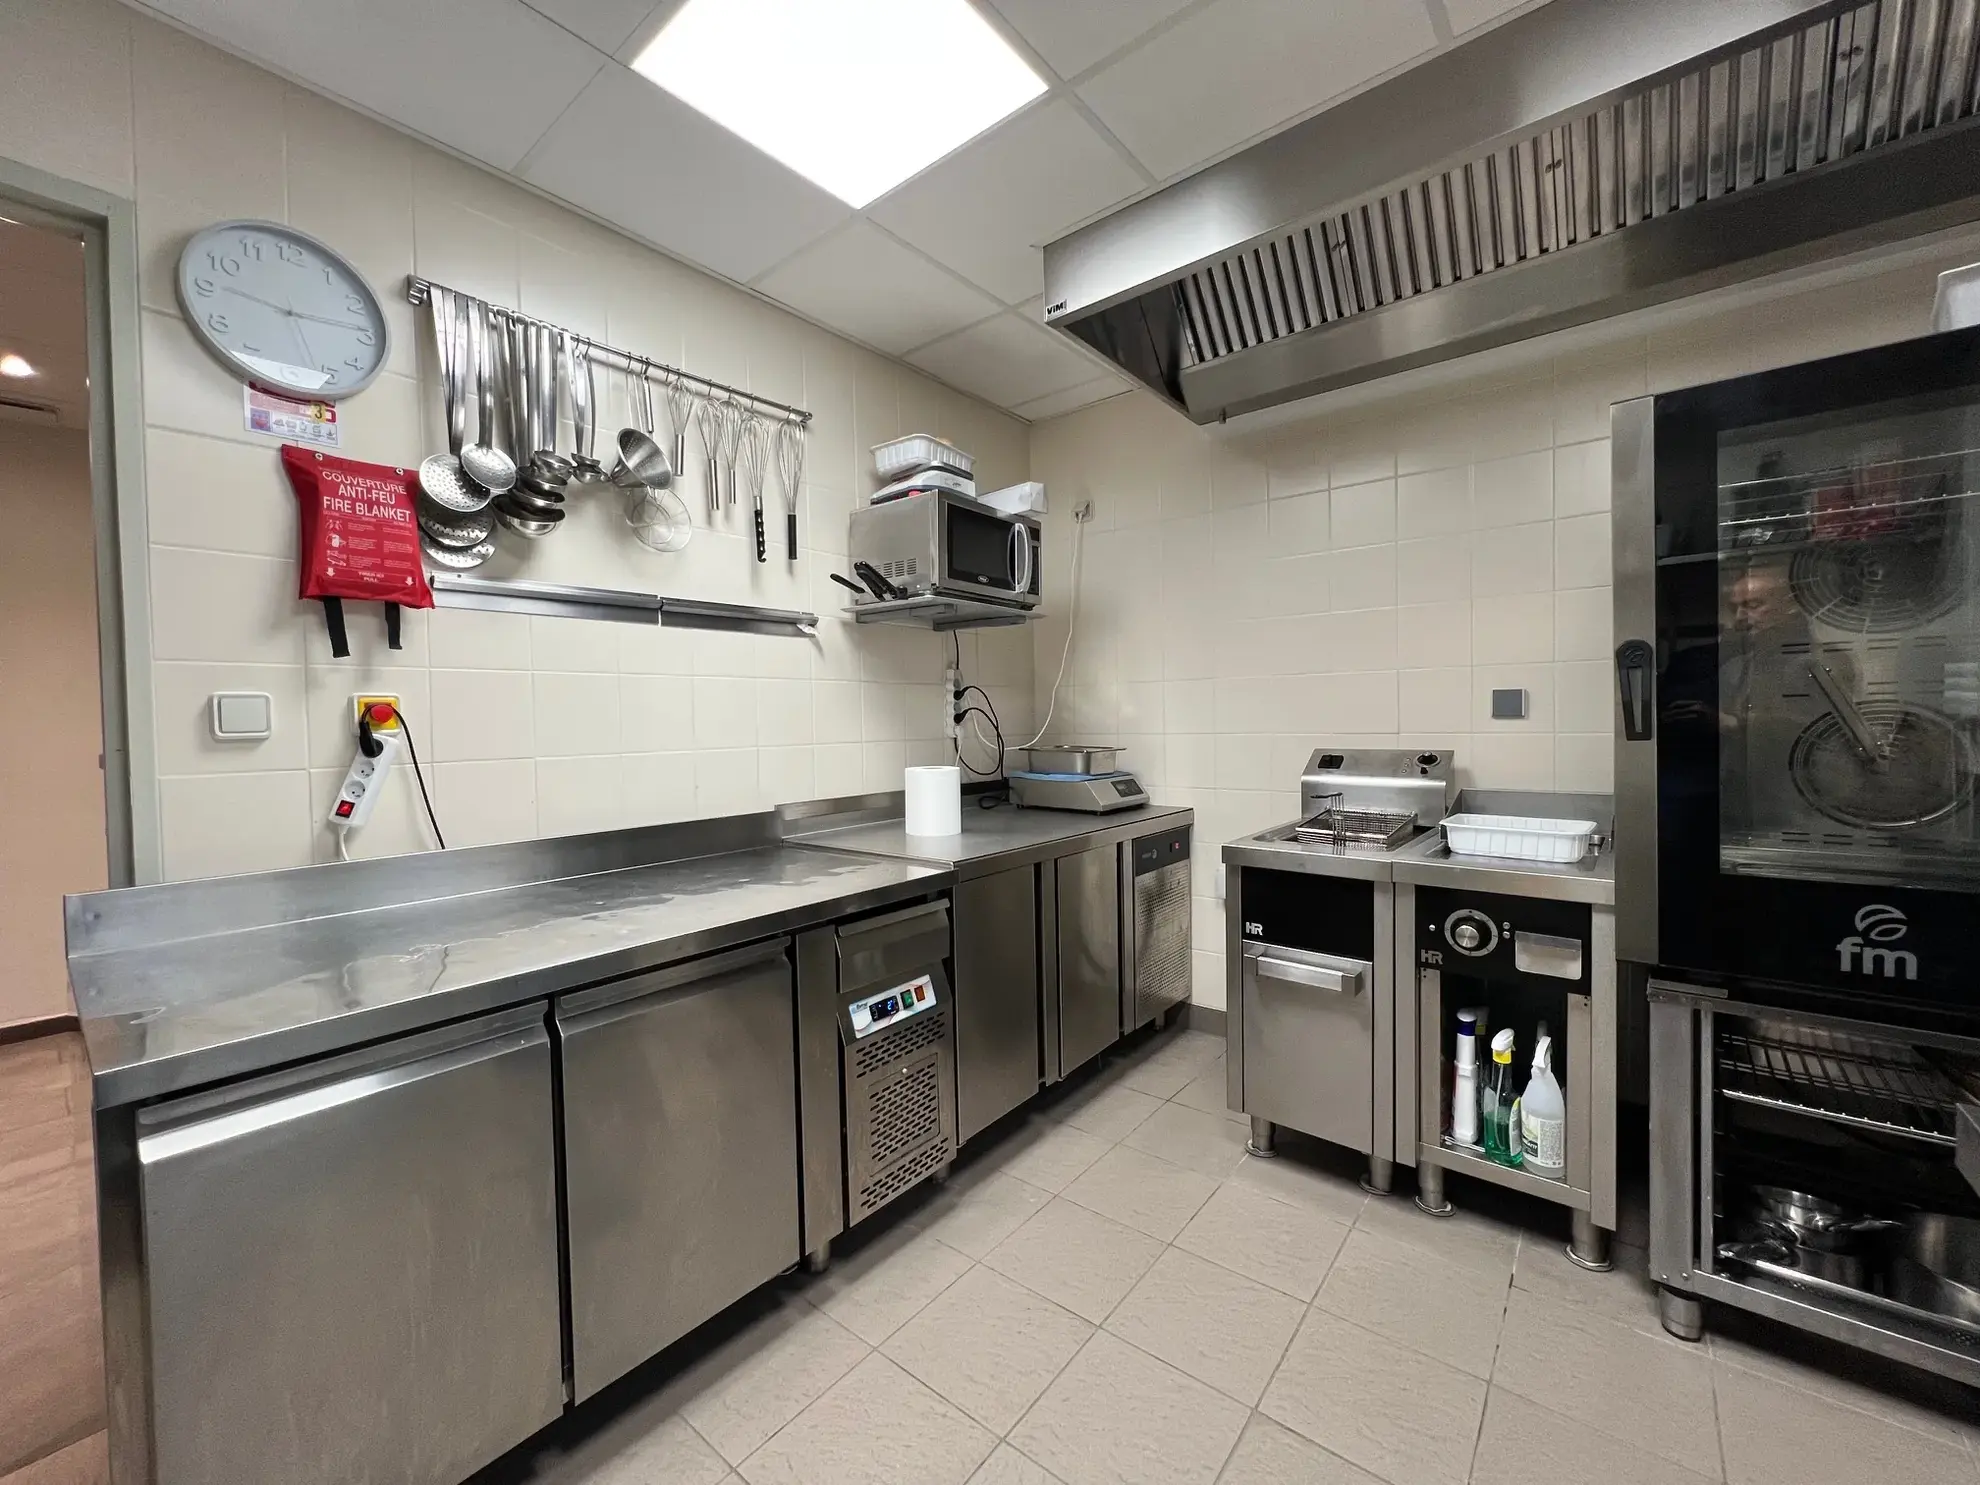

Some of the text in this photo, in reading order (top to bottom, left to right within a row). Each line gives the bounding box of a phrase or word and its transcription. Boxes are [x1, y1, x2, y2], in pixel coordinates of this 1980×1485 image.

[239, 236, 264, 261] 11
[275, 240, 307, 268] 12
[206, 251, 241, 277] 10
[194, 276, 215, 298] 9
[322, 266, 333, 286] 1
[345, 293, 366, 316] 2
[355, 324, 376, 347] 3
[320, 363, 339, 385] 5
[314, 403, 323, 420] 3
[322, 471, 407, 495] COUVERTURE
[338, 483, 396, 505] ANTI-FEU
[323, 496, 411, 522] FIRE BLANKET
[1245, 921, 1263, 936] HR
[1420, 949, 1443, 965] HR
[1835, 936, 1918, 980] fm
